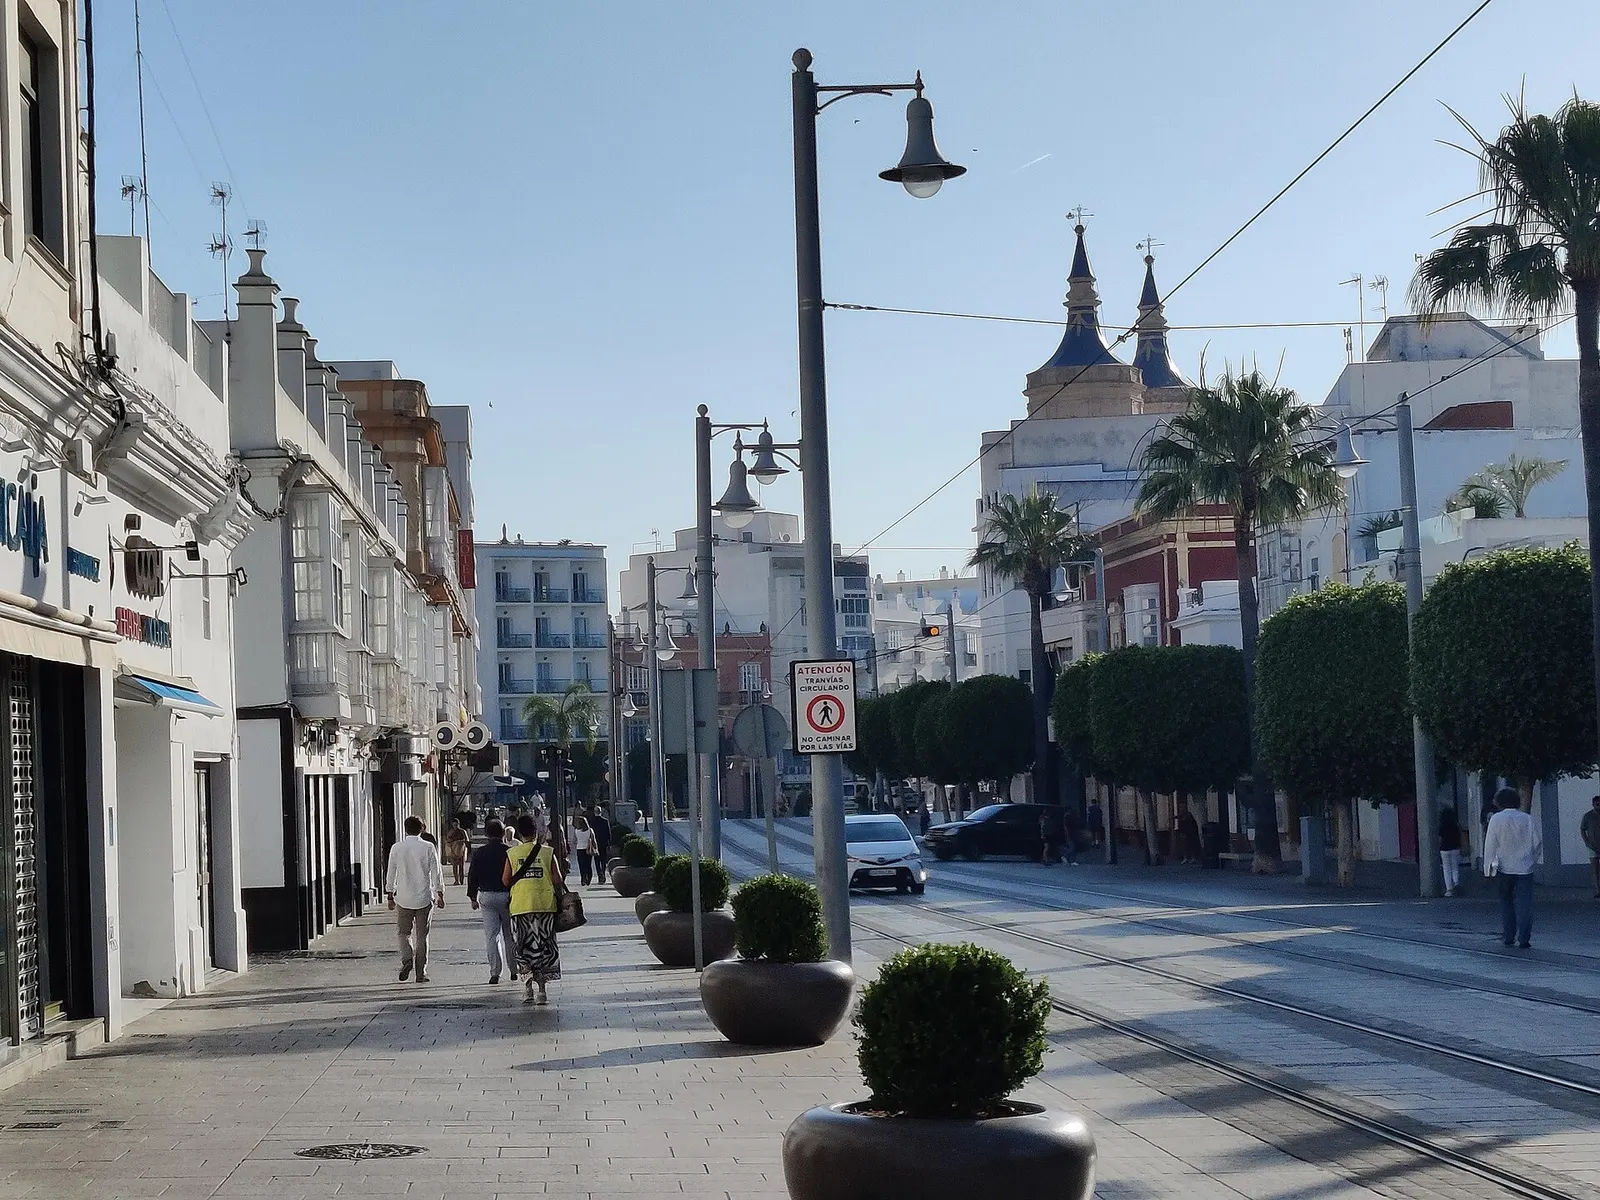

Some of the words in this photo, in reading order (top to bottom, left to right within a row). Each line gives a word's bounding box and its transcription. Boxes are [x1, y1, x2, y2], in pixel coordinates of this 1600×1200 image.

[460, 534, 471, 584] HOTEL
[797, 664, 851, 675] ATENCIÓN
[805, 676, 844, 684] TRANVÍAS
[799, 684, 850, 692] CIRCULANDO
[815, 735, 851, 743] CAMINAR
